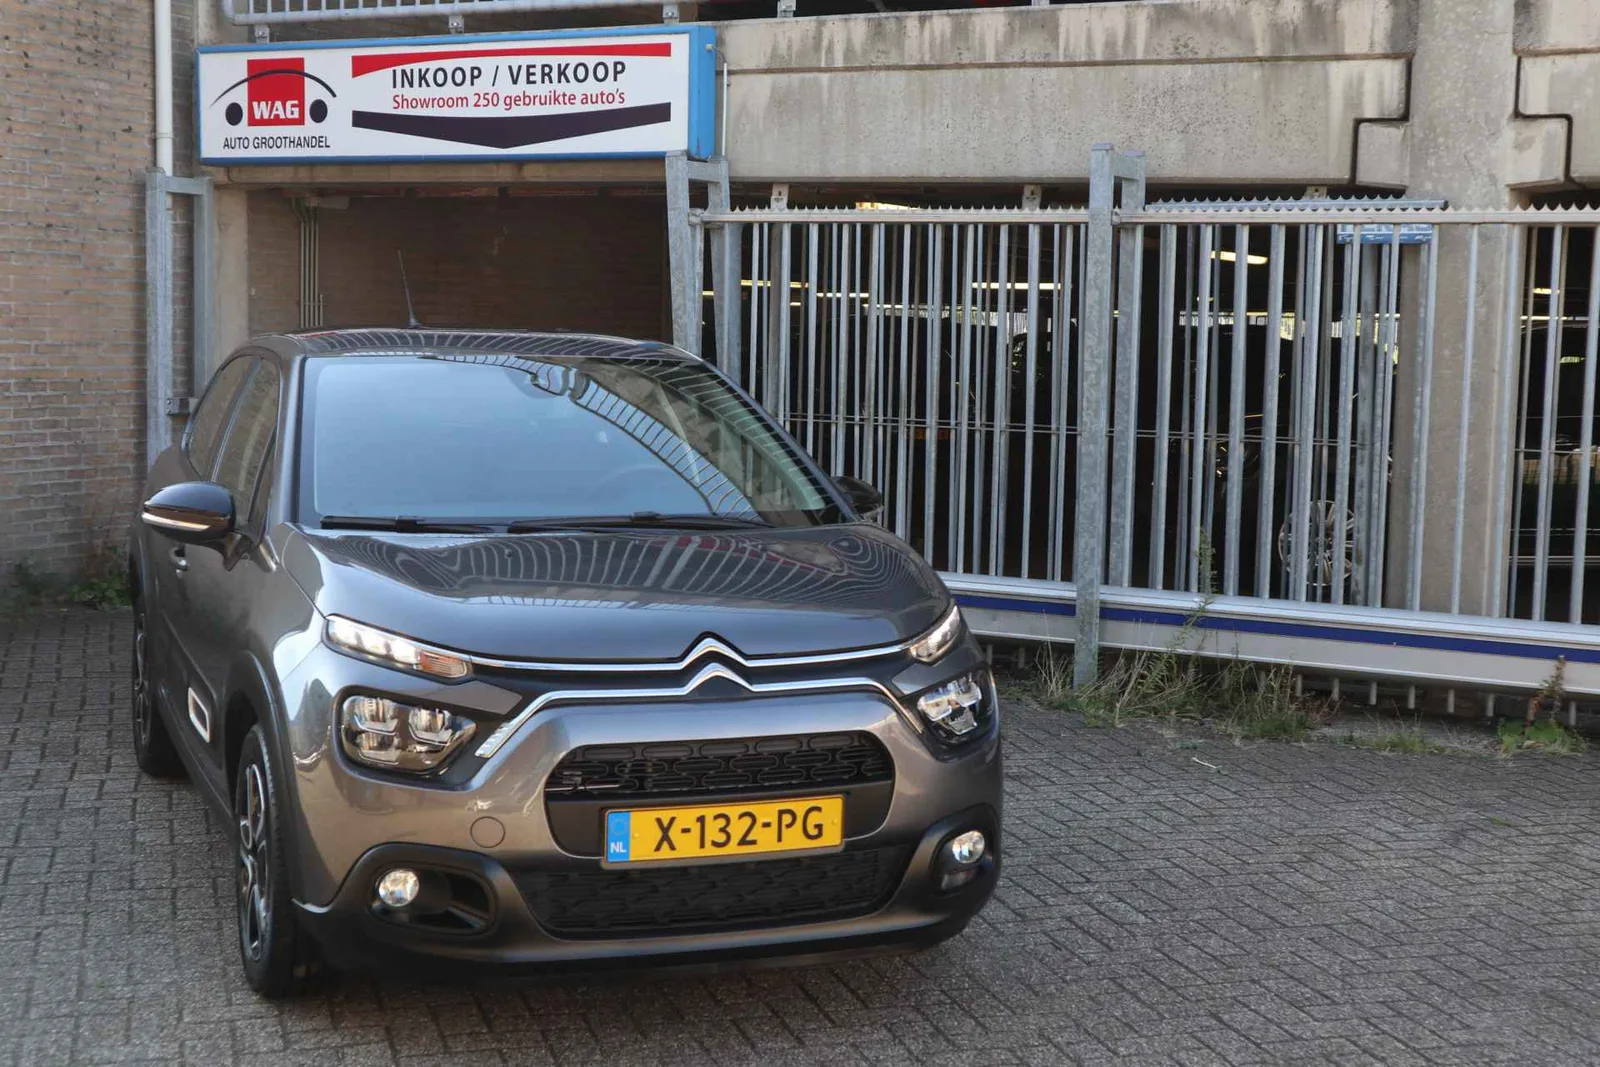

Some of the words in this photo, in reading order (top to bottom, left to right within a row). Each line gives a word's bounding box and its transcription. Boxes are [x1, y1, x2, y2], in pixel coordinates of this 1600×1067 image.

[392, 66, 482, 88] INKOOP
[492, 65, 499, 87] /
[508, 61, 626, 85] VERKOOP
[252, 100, 299, 120] WAG
[392, 93, 469, 110] Showroom
[473, 92, 499, 108] 250
[504, 90, 576, 111] gebruikte
[580, 88, 625, 105] auto's
[223, 137, 250, 149] AUTO
[252, 135, 331, 149] GROOTHANDEL
[653, 806, 824, 852] X-132-PG
[610, 842, 627, 853] NL
